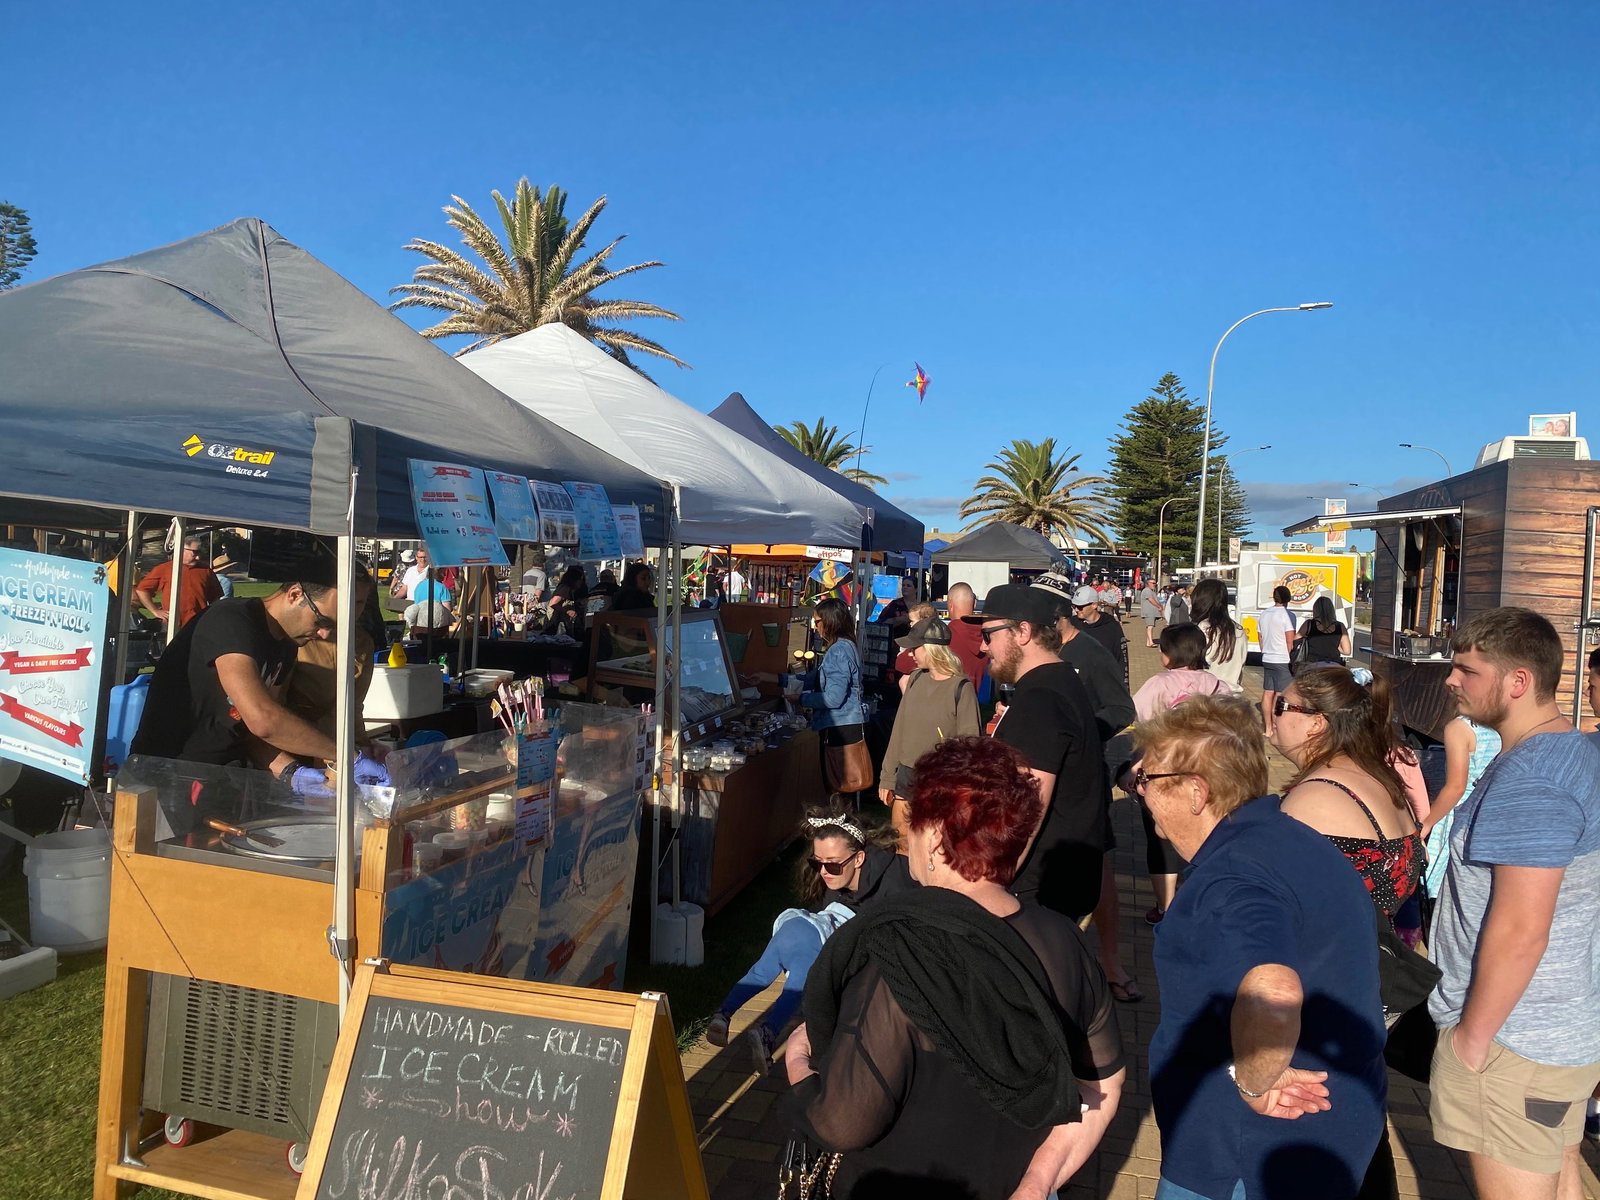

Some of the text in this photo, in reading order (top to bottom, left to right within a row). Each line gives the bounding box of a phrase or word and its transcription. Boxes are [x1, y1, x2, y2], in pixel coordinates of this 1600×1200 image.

[225, 465, 252, 476] Deluxe
[0, 575, 93, 615] ICE CREAM
[1036, 576, 1063, 590] PIES
[10, 604, 46, 623] FREEZE
[62, 612, 84, 631] ROLL
[43, 720, 67, 736] FLAVOURS
[373, 1006, 514, 1046] HANDMADE
[362, 1043, 582, 1111] ICE CREAM
